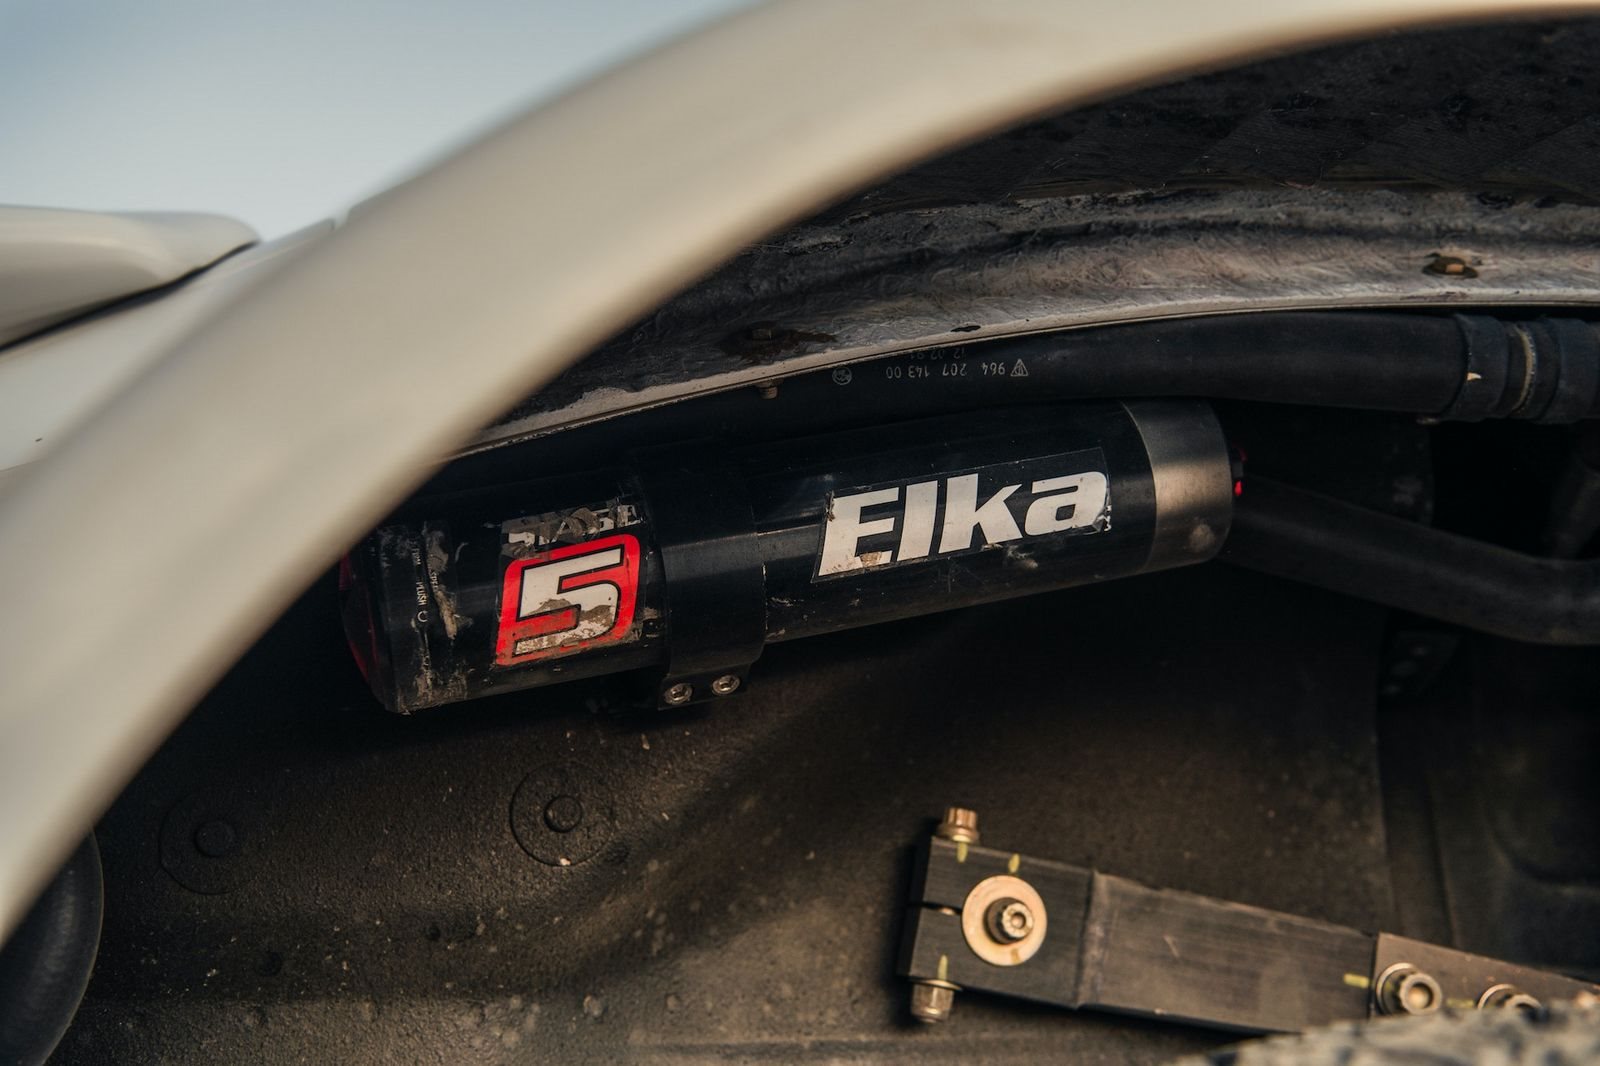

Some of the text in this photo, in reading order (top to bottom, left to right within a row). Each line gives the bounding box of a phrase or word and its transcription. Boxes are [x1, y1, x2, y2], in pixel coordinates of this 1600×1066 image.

[885, 361, 1006, 380] 964 207 143 00
[818, 471, 1108, 576] Elka
[512, 544, 625, 658] 5
